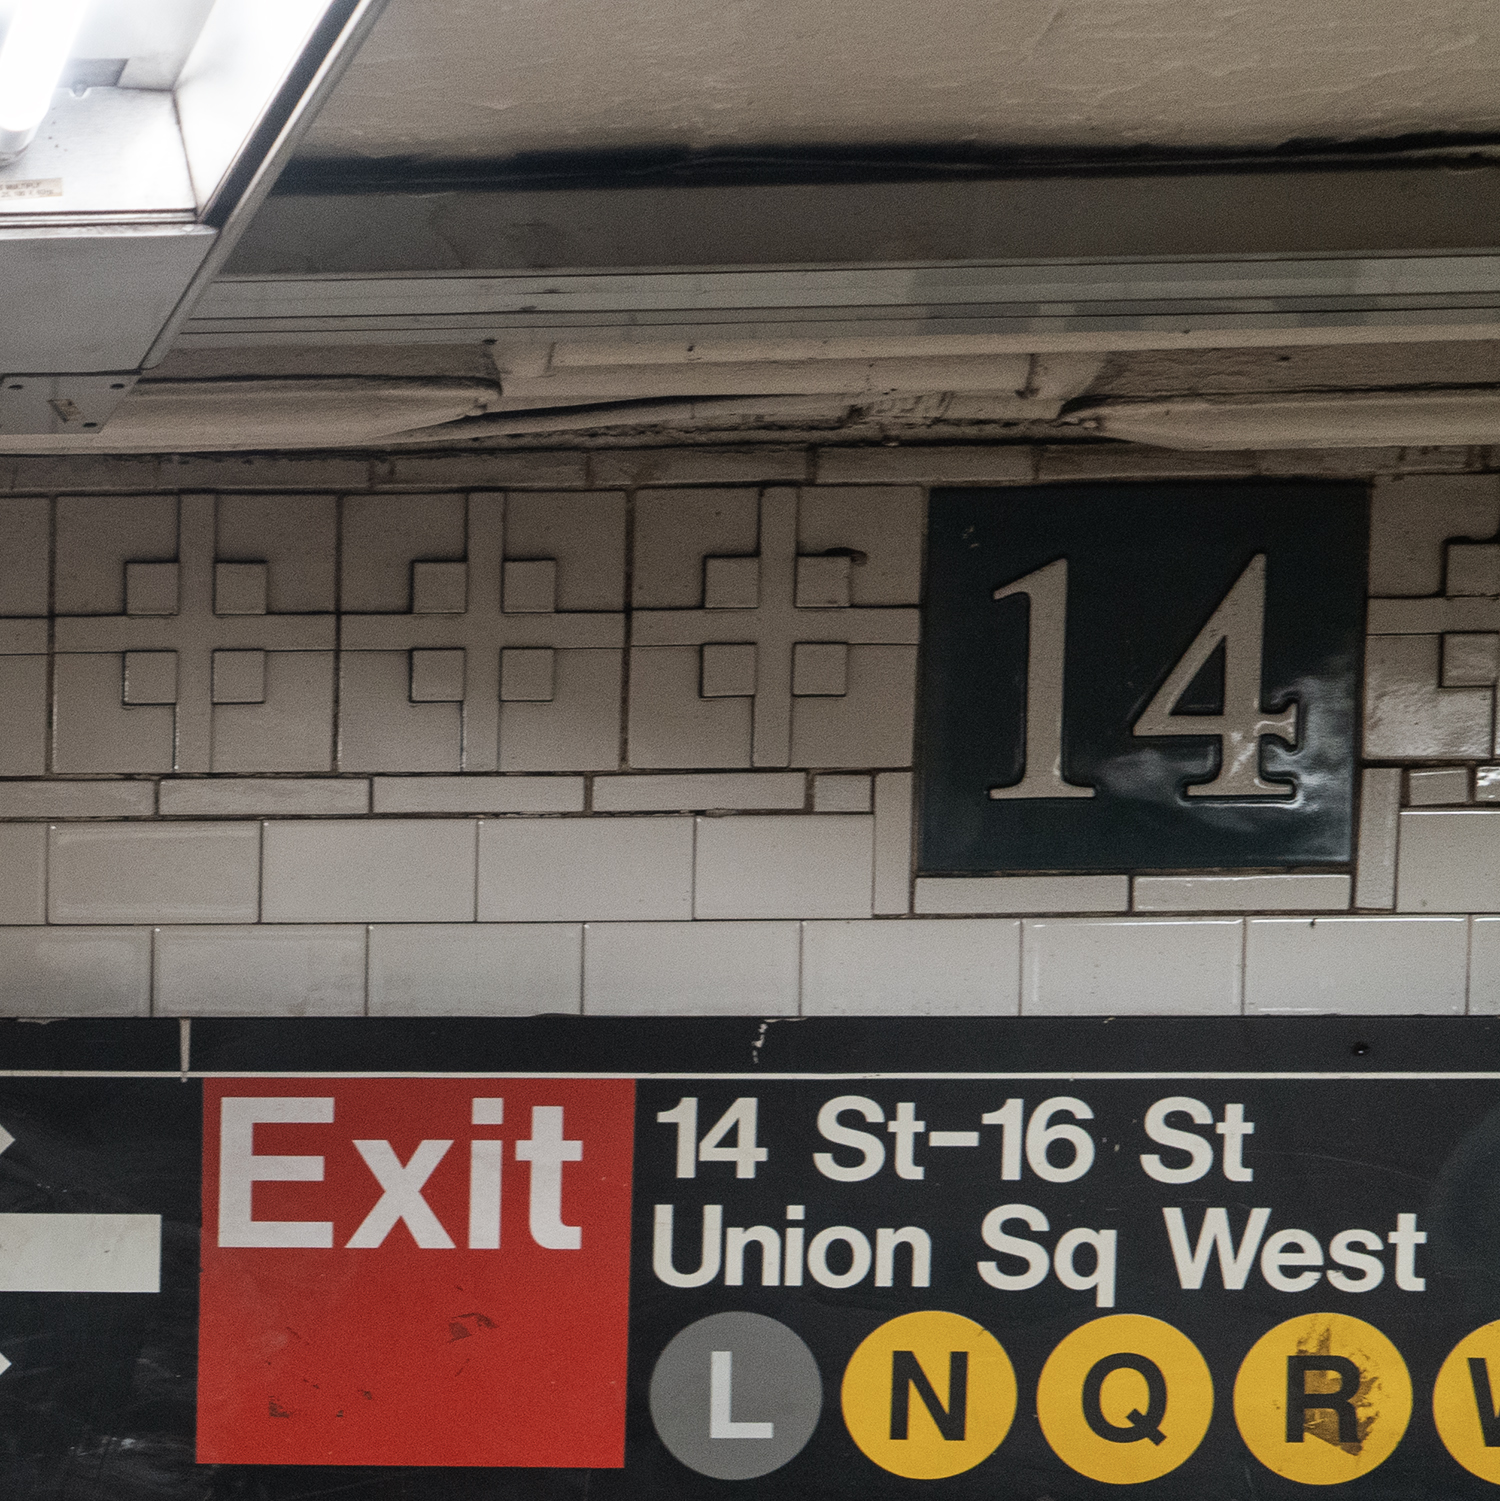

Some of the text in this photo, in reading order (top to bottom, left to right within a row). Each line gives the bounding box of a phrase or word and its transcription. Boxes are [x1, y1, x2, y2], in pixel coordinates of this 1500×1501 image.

[989, 553, 1299, 800] 14
[218, 1097, 583, 1249] Exit
[657, 1097, 768, 1178] 14
[1140, 1097, 1254, 1184] St
[653, 1204, 1427, 1307] Union Sq West
[710, 1350, 774, 1439] L
[889, 1350, 969, 1442] N
[1081, 1351, 1168, 1447] Q
[1285, 1355, 1364, 1444] R
